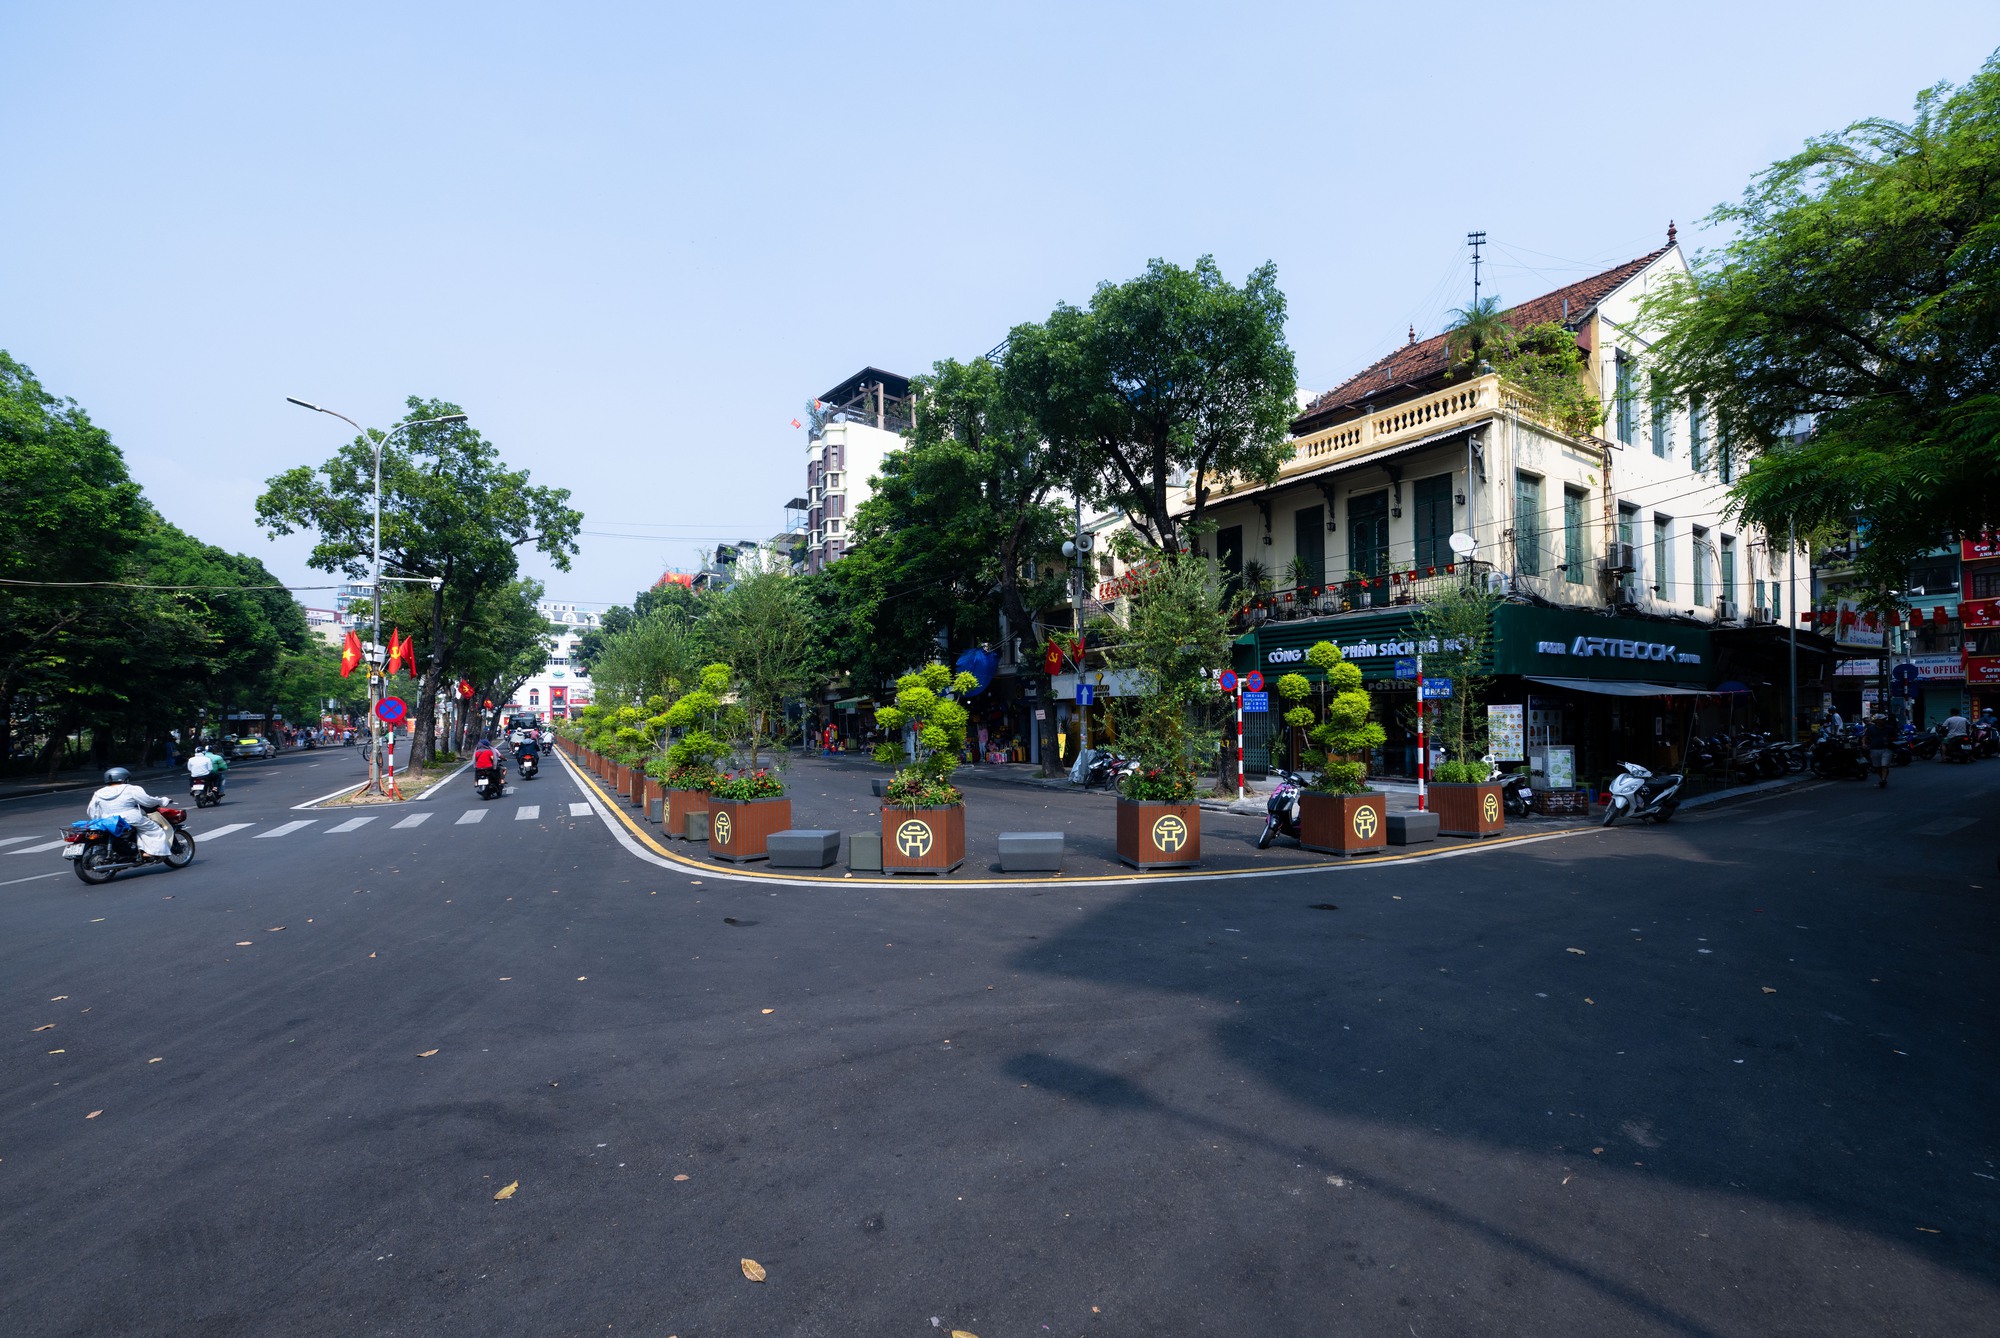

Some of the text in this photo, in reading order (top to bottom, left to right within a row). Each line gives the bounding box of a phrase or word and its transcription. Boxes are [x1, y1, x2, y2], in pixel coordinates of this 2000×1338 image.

[1268, 647, 1302, 664] CÔNG
[1341, 638, 1377, 659] PHẦN
[1379, 638, 1414, 656] SÁCH
[1418, 635, 1439, 654] HÀ
[1572, 635, 1676, 663] ARTBOOK
[1933, 665, 1964, 675] OFFICE
